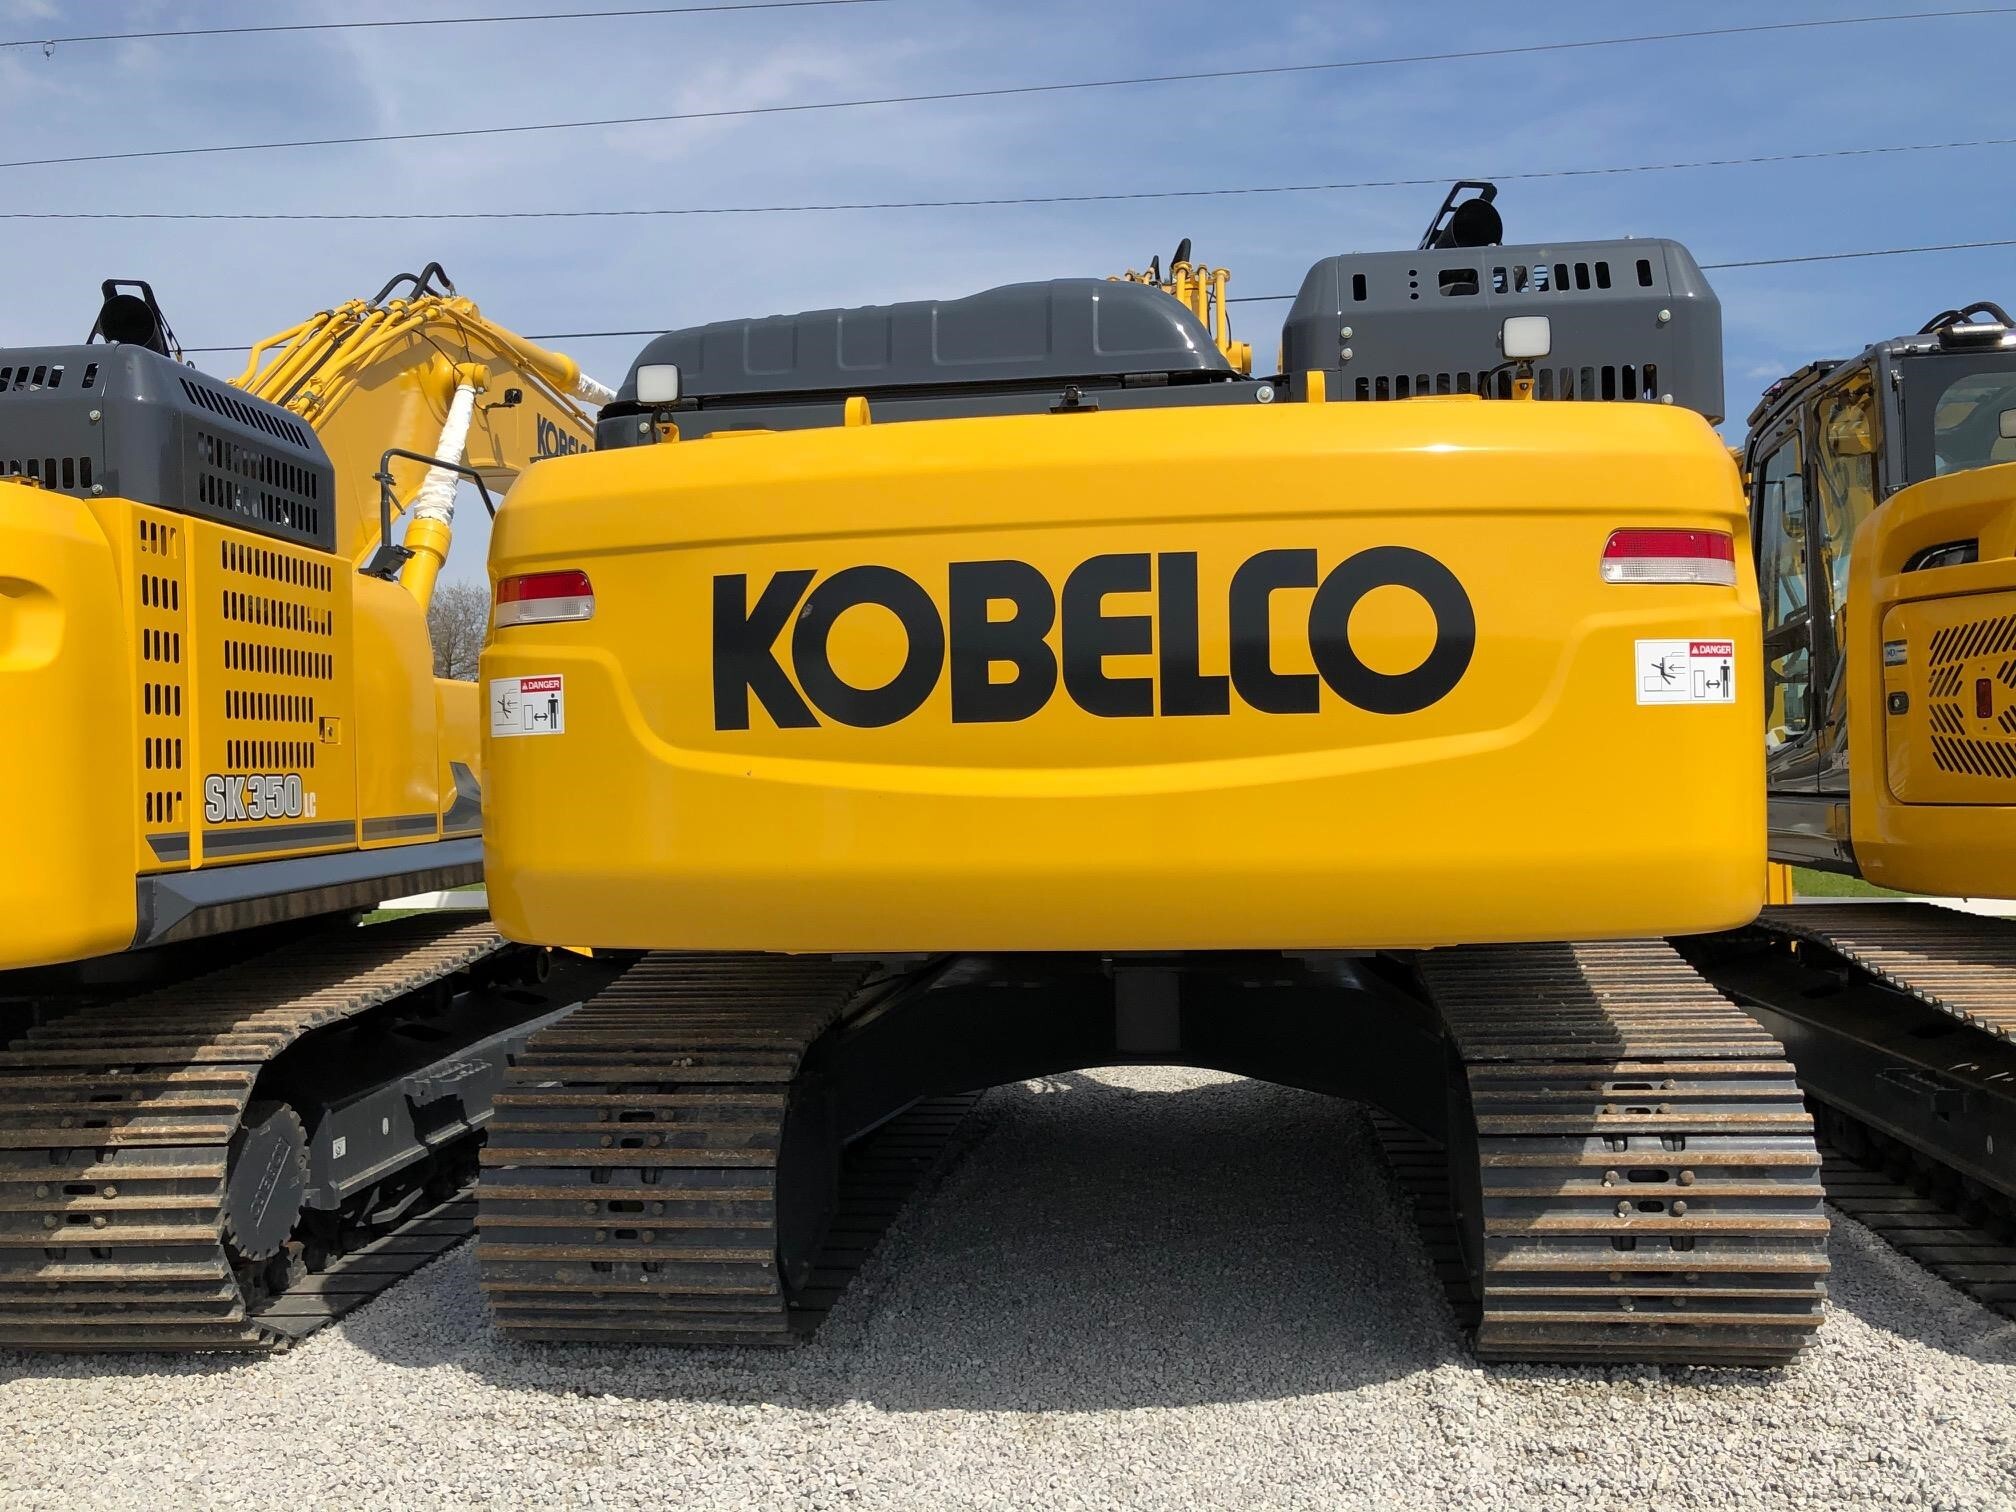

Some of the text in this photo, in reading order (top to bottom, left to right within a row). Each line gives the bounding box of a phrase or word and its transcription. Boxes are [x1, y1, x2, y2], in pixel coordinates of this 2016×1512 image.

[713, 545, 1476, 731] KOBELCO
[1700, 645, 1732, 655] DANGER
[528, 679, 560, 690] DANGER
[204, 773, 303, 824] SK350
